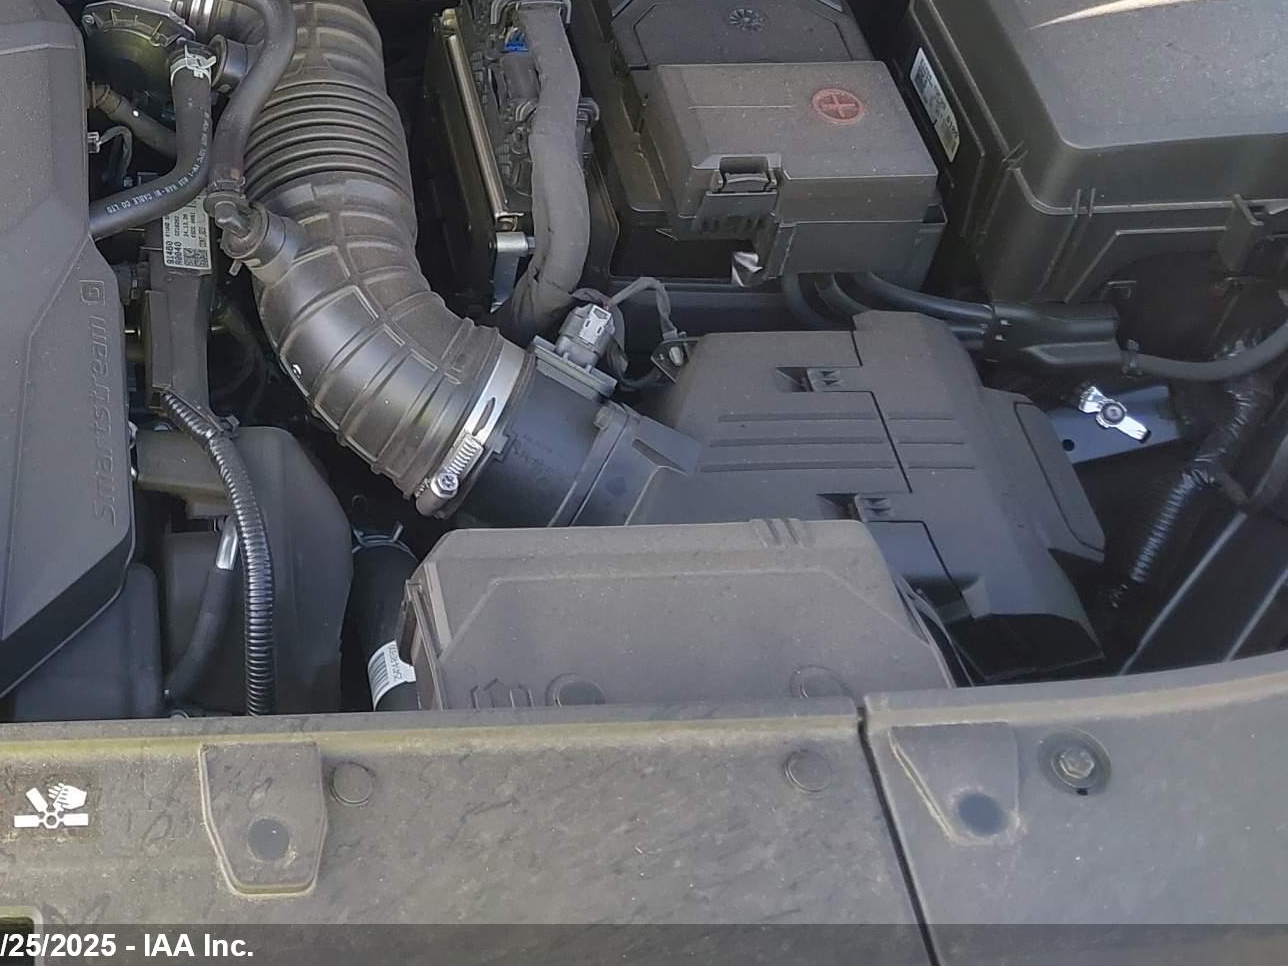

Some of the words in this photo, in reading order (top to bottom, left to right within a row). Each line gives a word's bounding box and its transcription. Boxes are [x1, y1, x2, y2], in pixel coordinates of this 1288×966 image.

[121, 199, 131, 209] CO
[131, 193, 153, 206] CABLE
[106, 204, 120, 214] LTD
[89, 315, 117, 529] Smartstream
